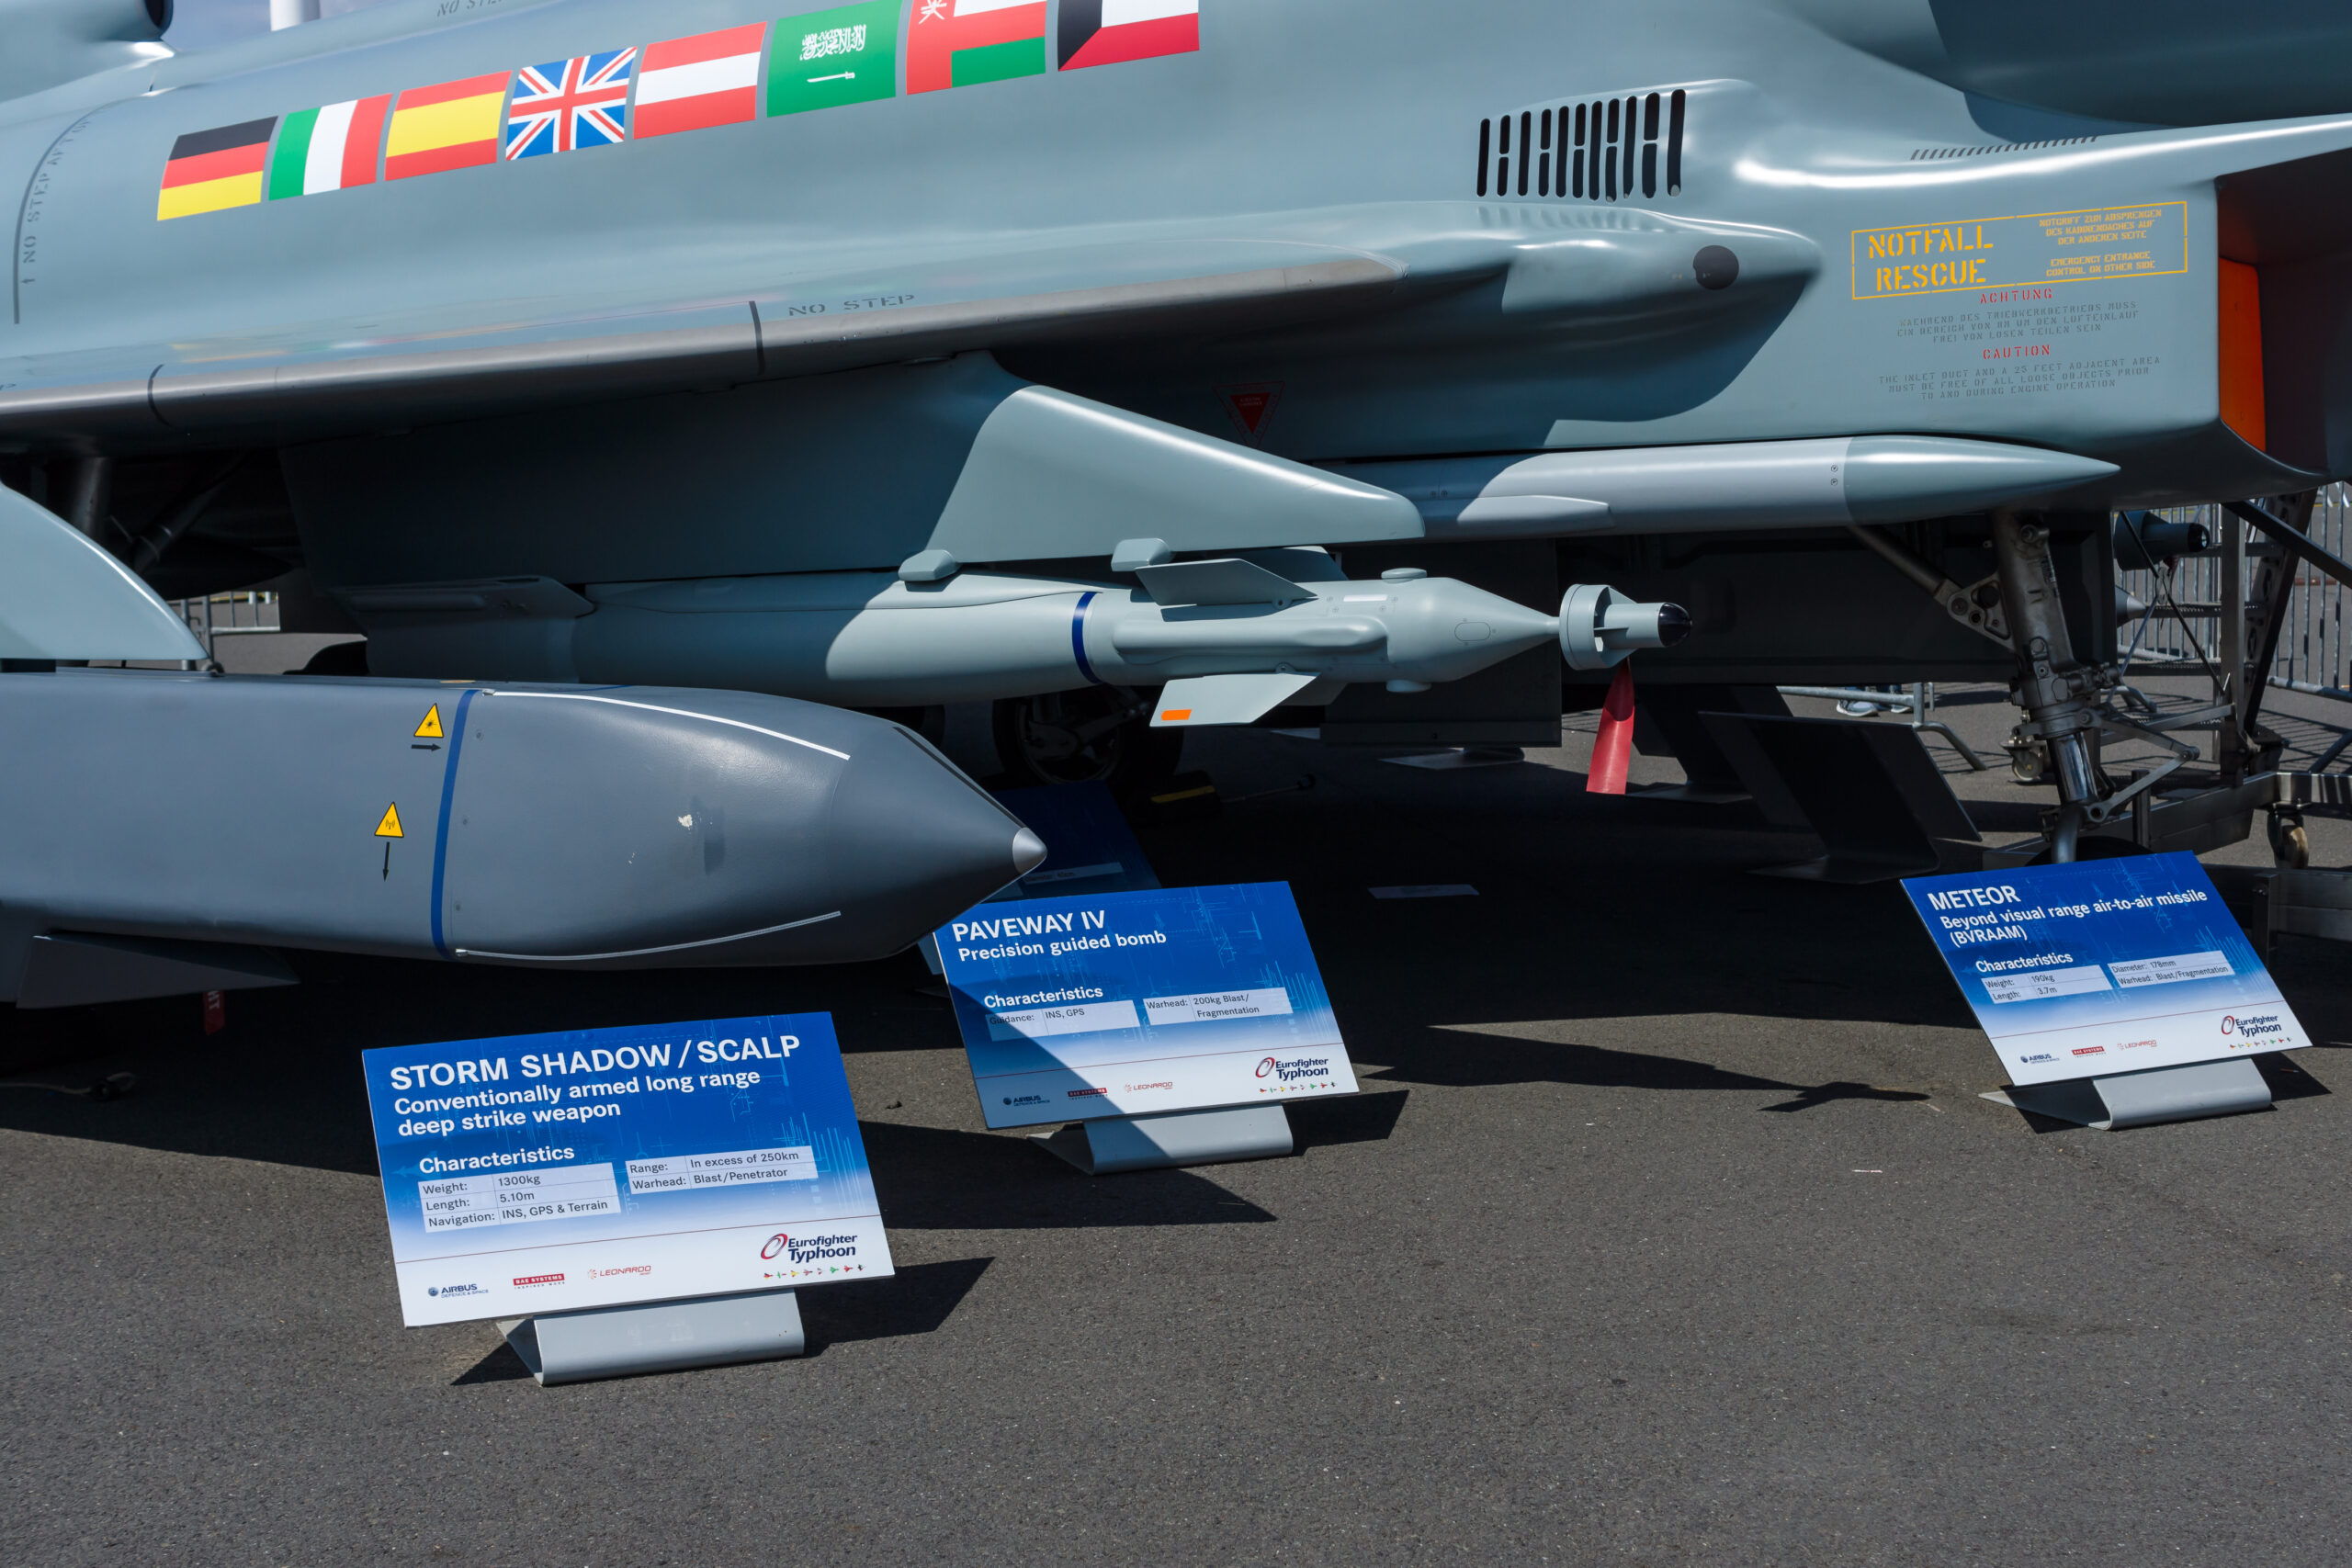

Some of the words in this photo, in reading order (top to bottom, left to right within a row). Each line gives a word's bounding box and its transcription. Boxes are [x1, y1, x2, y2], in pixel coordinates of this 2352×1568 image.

[27, 173, 51, 222] STEP
[2045, 228, 2062, 237] DES
[2138, 220, 2154, 228] AUF
[2086, 214, 2102, 223] ZUM
[1869, 225, 1994, 259] NOTFALL
[2058, 237, 2075, 245] DER
[2078, 233, 2118, 243] ANDEREN
[2121, 230, 2146, 240] SEITE
[23, 236, 36, 263] NO
[2051, 255, 2100, 266] EMERGENCY
[2104, 251, 2150, 263] ENTRANCE
[1877, 259, 1986, 292] RESCUE
[2046, 266, 2086, 276] CONTROL
[2104, 263, 2132, 272] OTHER
[2136, 260, 2155, 269] SIDE
[788, 303, 825, 316] NO
[843, 294, 915, 310] STEP
[1981, 288, 2052, 304] ACHTUNG
[1961, 313, 1980, 321] DES
[2108, 301, 2137, 310] MUSS
[1897, 329, 1914, 337] EIN
[1971, 322, 1990, 331] VON
[2036, 316, 2056, 325] DEN
[1933, 334, 1957, 344] FREI
[1963, 333, 1983, 341] VON
[1989, 330, 2023, 339] LOSEN
[2031, 325, 2069, 336] TEILEN
[2076, 323, 2101, 333] SEIN
[1983, 344, 2050, 359] CAUTION
[1879, 375, 1898, 384] THE
[1905, 372, 1936, 382] INLET
[1941, 369, 1968, 379] DUCT
[1975, 367, 1996, 377] AND
[2014, 366, 2028, 374] 25
[2034, 363, 2063, 372] FEET
[2069, 358, 2124, 369] ADJACENT
[2132, 356, 2160, 366] AREA
[1889, 384, 1915, 393] MUST
[1922, 382, 1934, 390] BE
[1940, 379, 1968, 389] FREE
[1974, 378, 1987, 387] OF
[1994, 377, 2014, 385] ALL
[2021, 373, 2055, 383] LOOSE
[2062, 369, 2111, 380] OBJECTS
[2118, 367, 2150, 377] PRIOR
[1940, 390, 1960, 399] AND
[1966, 387, 2005, 397] DURING
[2010, 384, 2050, 394] ENGINE
[2056, 379, 2115, 390] OPERATION
[1928, 886, 2021, 911] METEOR
[1939, 911, 1997, 931] Beyond
[1999, 906, 2045, 922] visual
[2047, 904, 2091, 919] range
[2093, 895, 2154, 913] air-to-air
[2155, 889, 2208, 906] missile
[952, 912, 1073, 942] PAVEWAY
[1080, 909, 1105, 930] IV
[957, 942, 1045, 962] Precision
[1050, 935, 1112, 956] guided
[1115, 930, 1167, 947] bomb
[1950, 924, 2028, 948] (BVRAAM)
[1975, 952, 2074, 973] Characteristics
[2111, 964, 2148, 974] Diameter:
[1985, 979, 2015, 988] Weight:
[2031, 975, 2055, 983] 190kg
[2118, 974, 2154, 985] Warhead:
[984, 987, 1103, 1009] Characteristics
[1147, 999, 1188, 1010] Warhead:
[1193, 996, 1222, 1005] 200kg
[1223, 993, 1250, 1003] Blast/
[1992, 991, 2021, 1001] Length:
[2037, 987, 2058, 996] 3.7m
[989, 1015, 1035, 1025] Guidance:
[1045, 1010, 1065, 1020] INS,
[1066, 1009, 1085, 1018] GPS
[1196, 1006, 1260, 1019] Fragmentation
[2235, 1016, 2278, 1026] Eurofighter
[2238, 1023, 2282, 1037] Typhoon
[390, 1057, 509, 1090] STORM
[520, 1043, 671, 1078] SHADOW
[696, 1035, 800, 1064] SCALP
[1275, 1058, 1329, 1068] Eurofighter
[1276, 1067, 1329, 1081] Typhoon
[394, 1084, 561, 1115] Conventionally
[569, 1077, 639, 1099] armed
[645, 1075, 695, 1093] long
[699, 1071, 761, 1089] range
[398, 1119, 455, 1136] deep
[461, 1110, 526, 1130] strike
[532, 1103, 621, 1123] weapon
[419, 1146, 575, 1174] Characteristics
[629, 1162, 668, 1174] Range:
[690, 1159, 701, 1168] In
[705, 1156, 743, 1168] excess
[746, 1155, 758, 1164] of
[761, 1152, 799, 1163] 250km
[423, 1181, 468, 1195] Weight:
[498, 1175, 541, 1187] 1300kg
[632, 1177, 687, 1190] Warhead:
[693, 1168, 788, 1184] Blast/Penetrator
[425, 1199, 470, 1212] Length:
[500, 1191, 535, 1203] 5.10m
[428, 1213, 495, 1227] Navigation:
[502, 1208, 526, 1220] INS,
[529, 1205, 553, 1216] GPS
[557, 1205, 565, 1213] &
[567, 1201, 608, 1212] Terrain
[788, 1235, 858, 1247] Eurofighter
[788, 1246, 856, 1264] Typhoon
[599, 1265, 651, 1277] LEONARDO
[441, 1283, 478, 1293] AIRBUS
